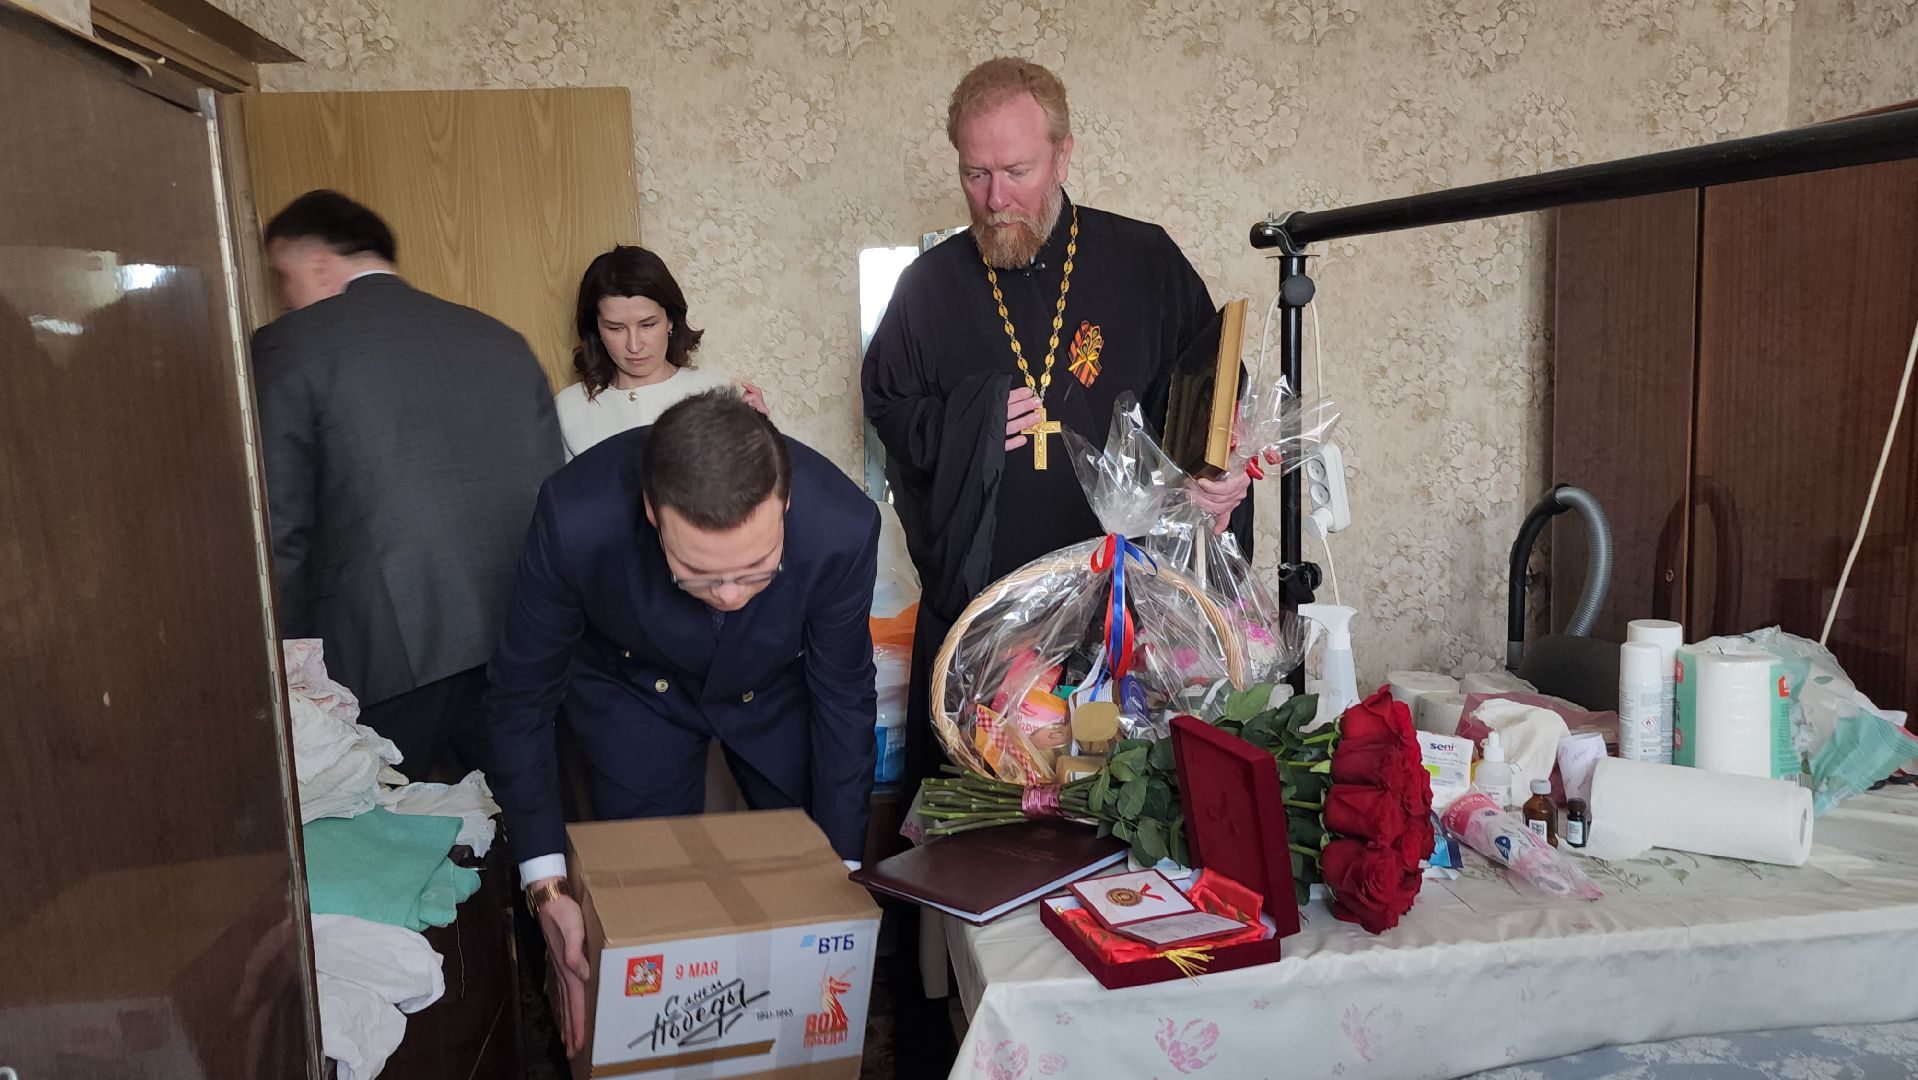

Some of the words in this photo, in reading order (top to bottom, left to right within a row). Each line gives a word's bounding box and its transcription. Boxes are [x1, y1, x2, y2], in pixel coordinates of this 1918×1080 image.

[1430, 742, 1454, 751] seni
[818, 933, 854, 954] ВТБ
[675, 963, 684, 980] 9
[689, 960, 719, 978] МАЯ
